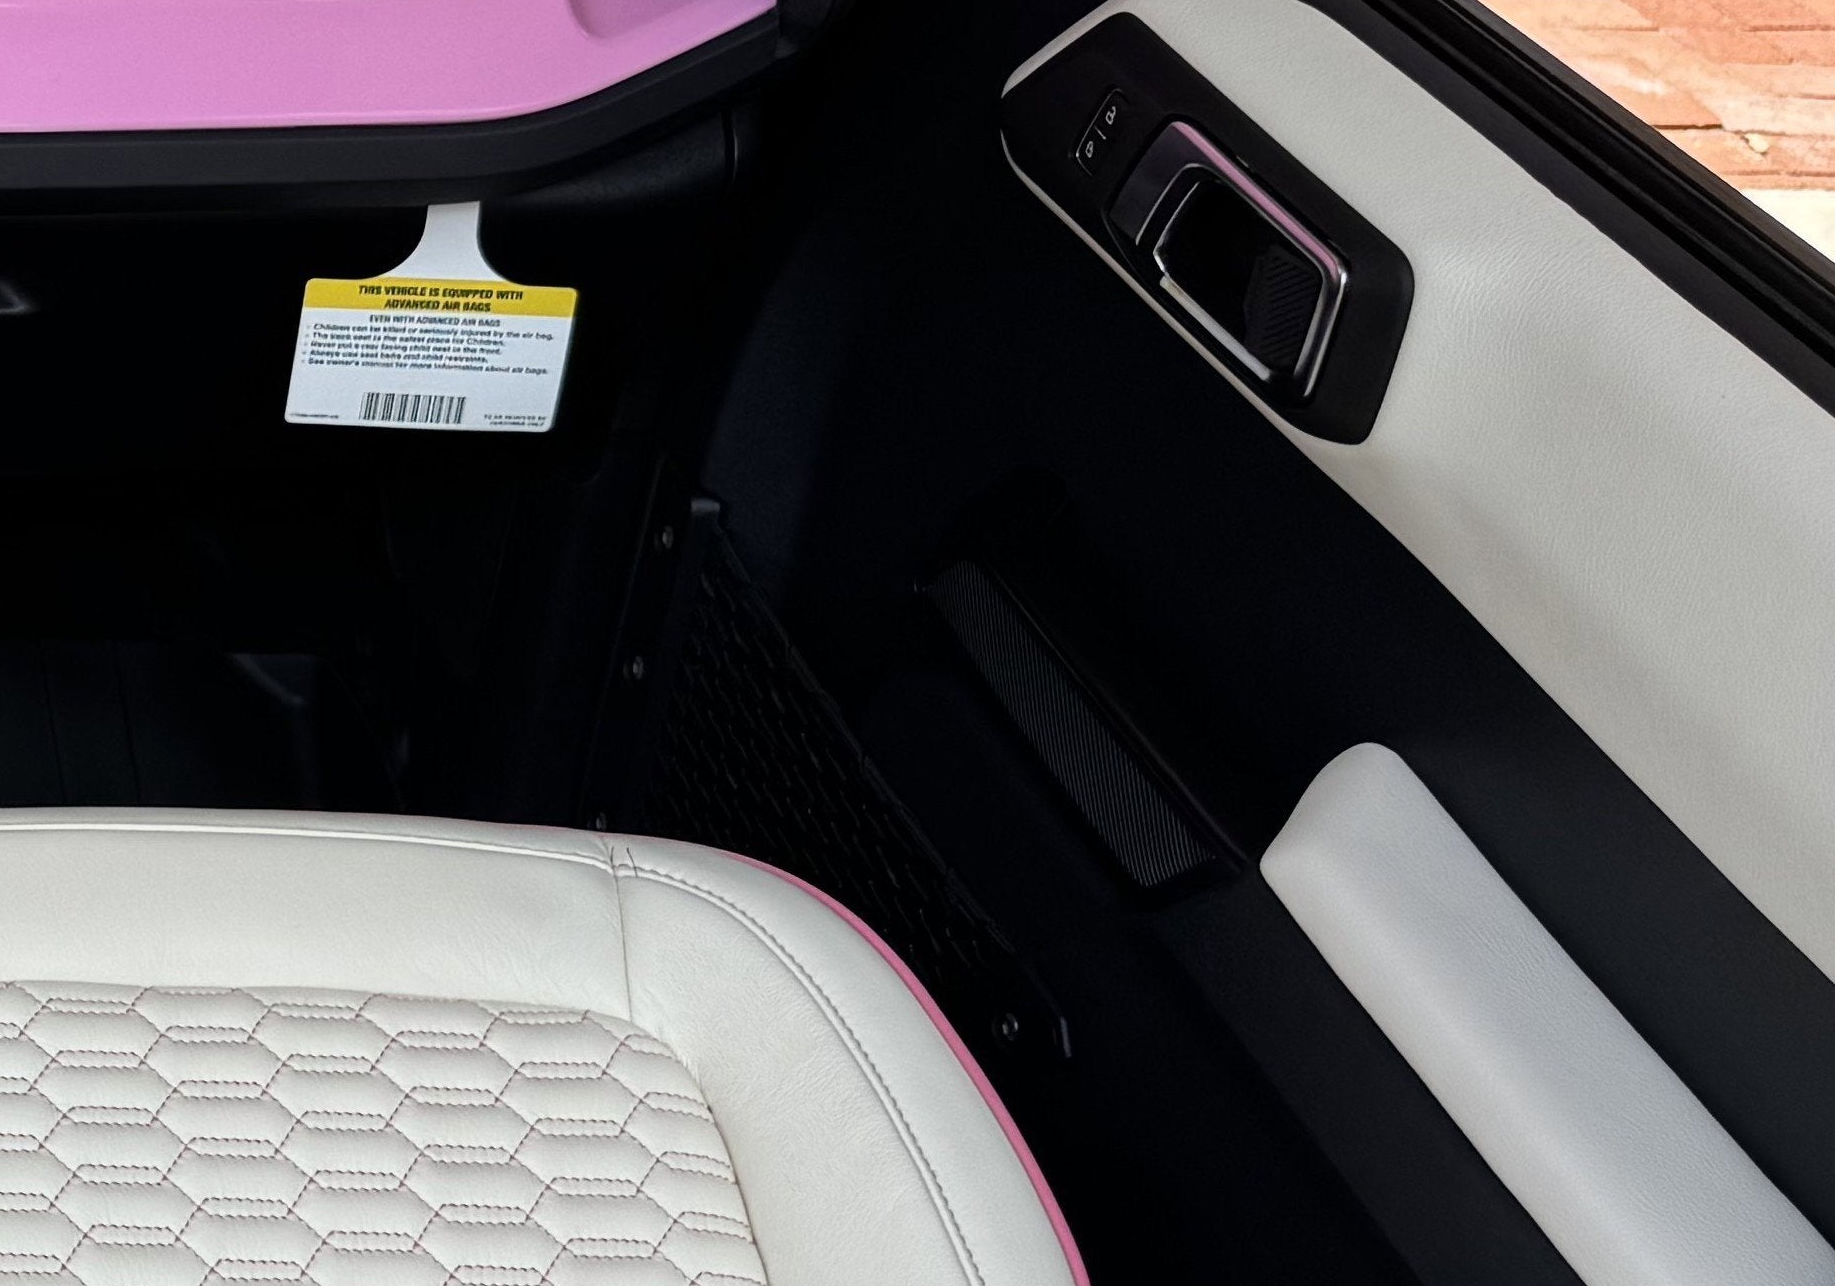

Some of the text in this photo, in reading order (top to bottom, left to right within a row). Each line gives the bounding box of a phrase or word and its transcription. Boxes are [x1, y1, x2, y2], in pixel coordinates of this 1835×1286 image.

[384, 286, 427, 297] VEHICLE
[428, 287, 439, 297] IS
[442, 288, 493, 299] EQUIPPED
[496, 290, 523, 300] WITH
[384, 299, 440, 310] ADVANCED
[442, 301, 461, 312] AIR
